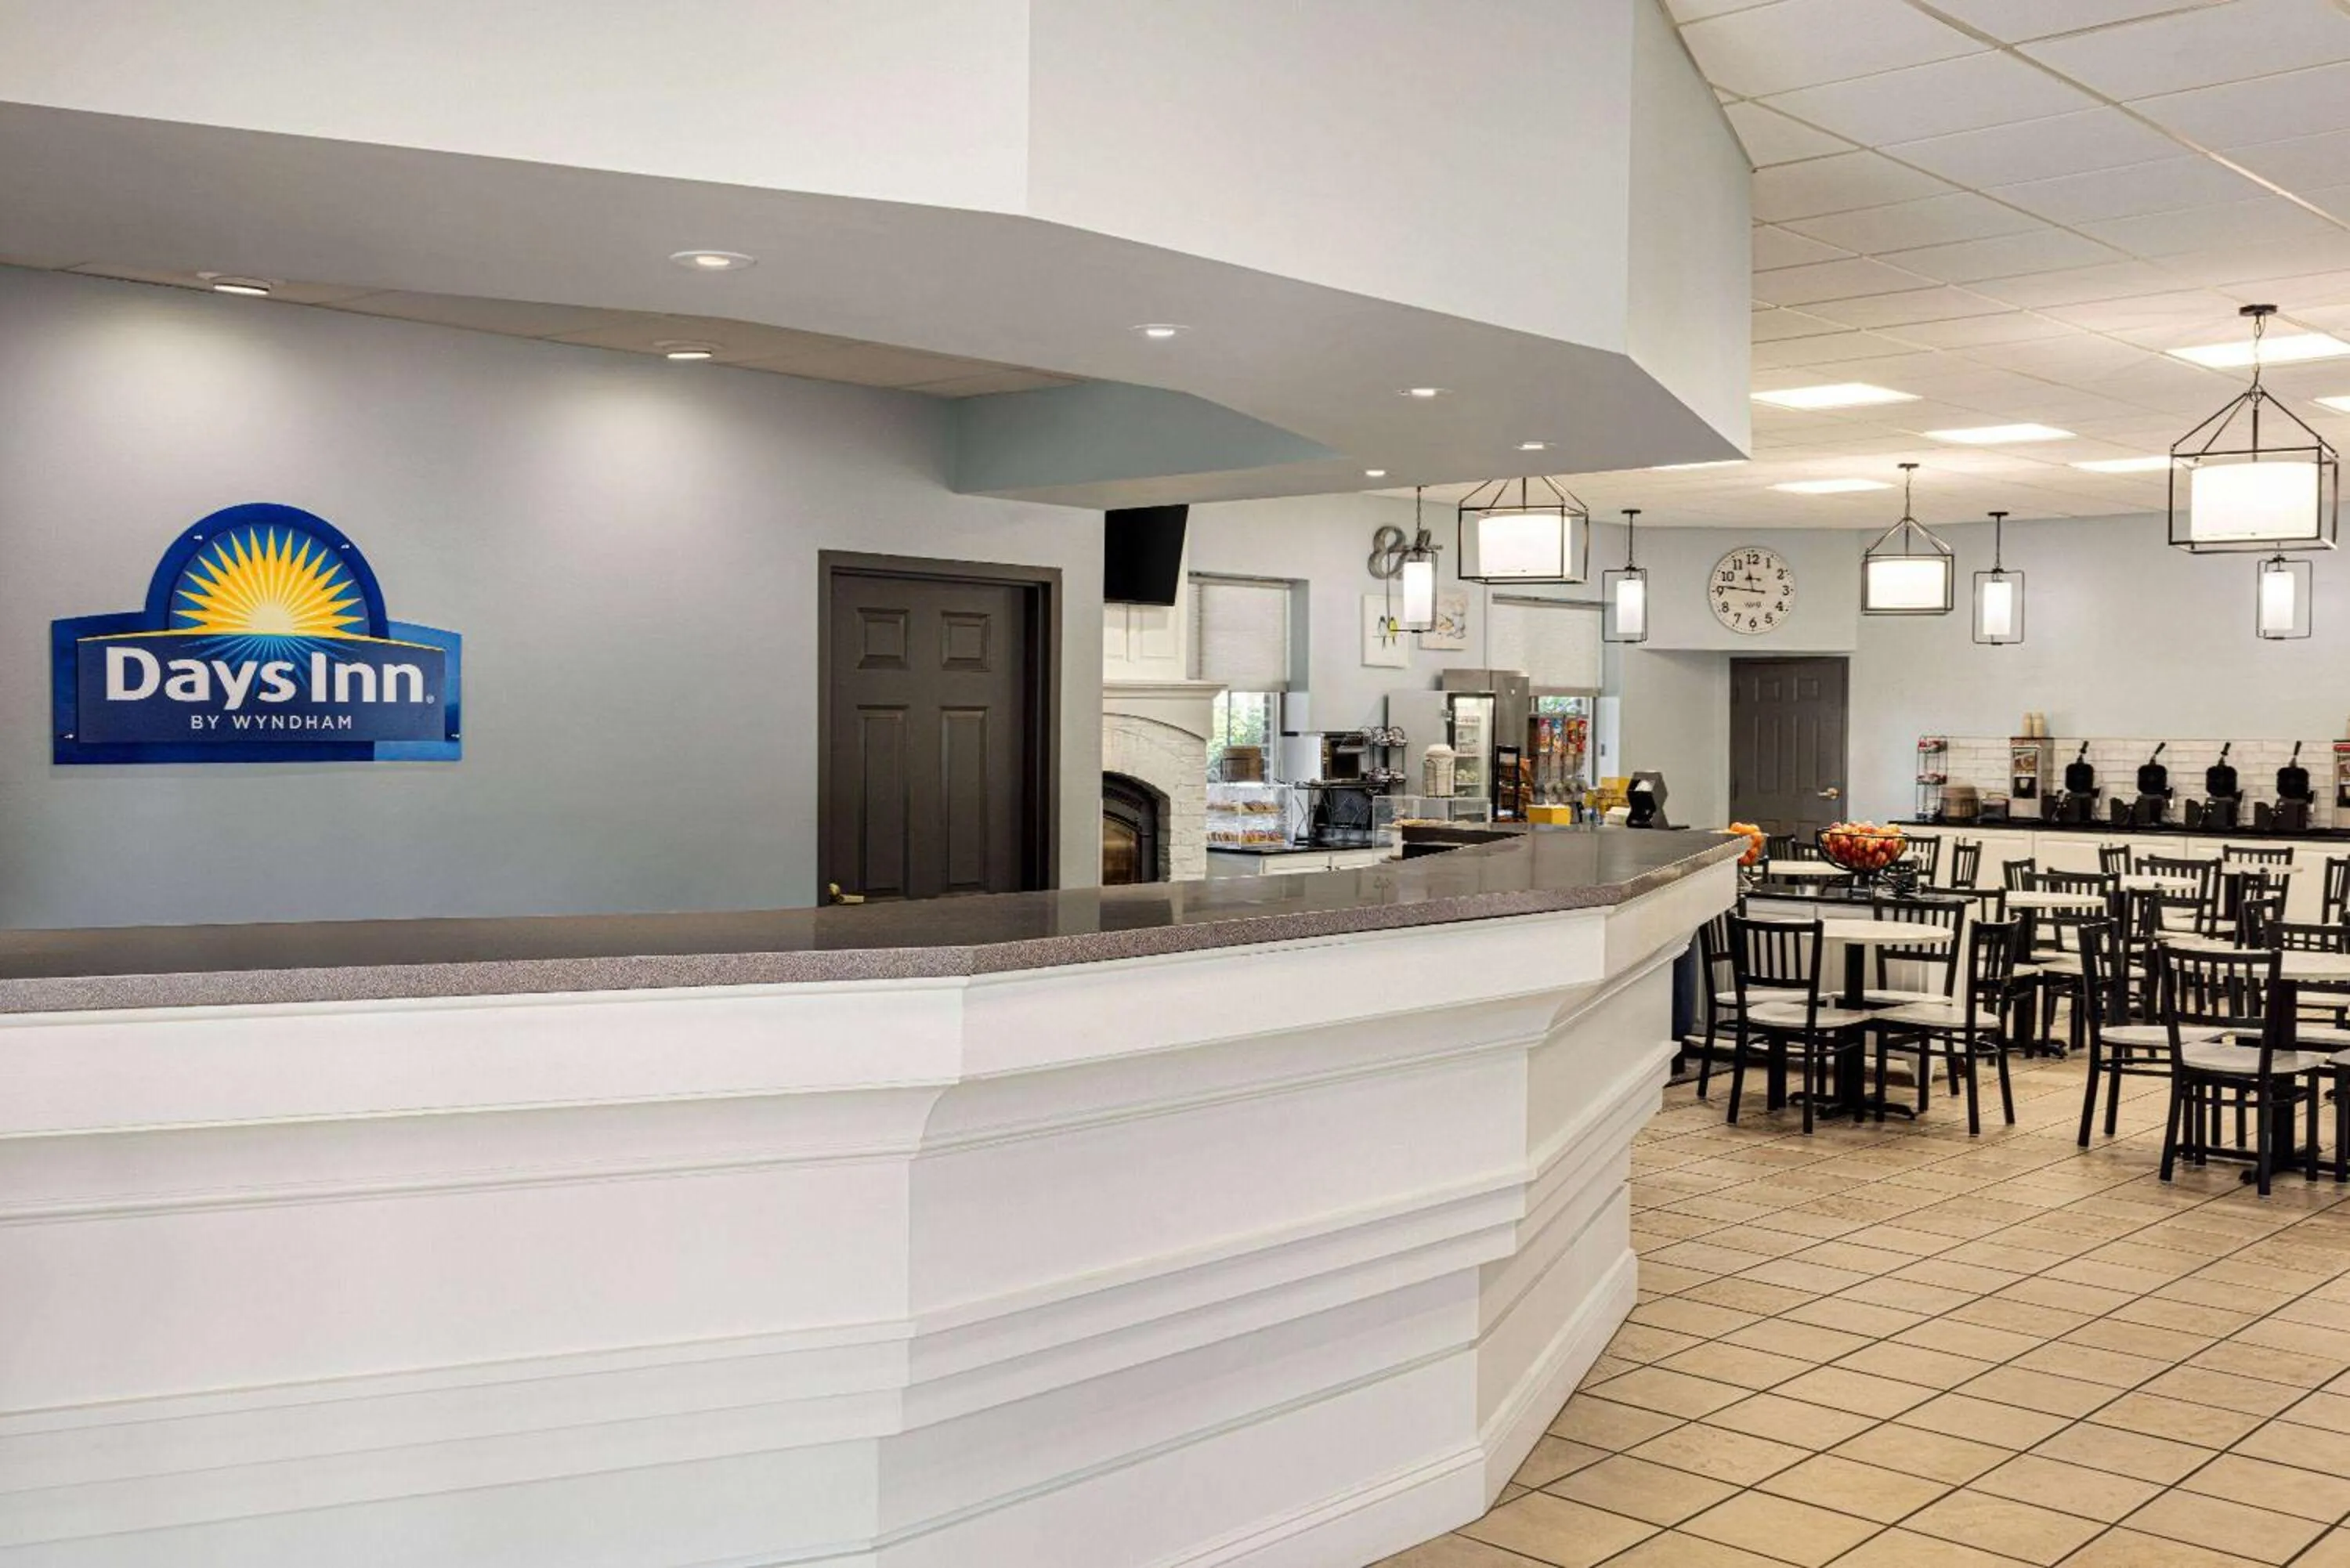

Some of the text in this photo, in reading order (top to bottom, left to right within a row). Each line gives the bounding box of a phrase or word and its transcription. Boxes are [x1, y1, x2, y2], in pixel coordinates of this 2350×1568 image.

[1733, 558, 1743, 570] 11
[1746, 554, 1759, 565] 12
[1766, 557, 1771, 569] 1
[1721, 571, 1735, 582] 10
[1776, 568, 1784, 580] 2
[1716, 585, 1724, 597] 9
[1782, 585, 1790, 596] 3
[1721, 601, 1730, 613] 8
[1775, 601, 1784, 612] 4
[1734, 612, 1741, 623] 7
[1748, 616, 1757, 628] 6
[1764, 612, 1773, 624] 5
[106, 647, 297, 710] Days
[190, 714, 352, 730] BY WYNDHAM
